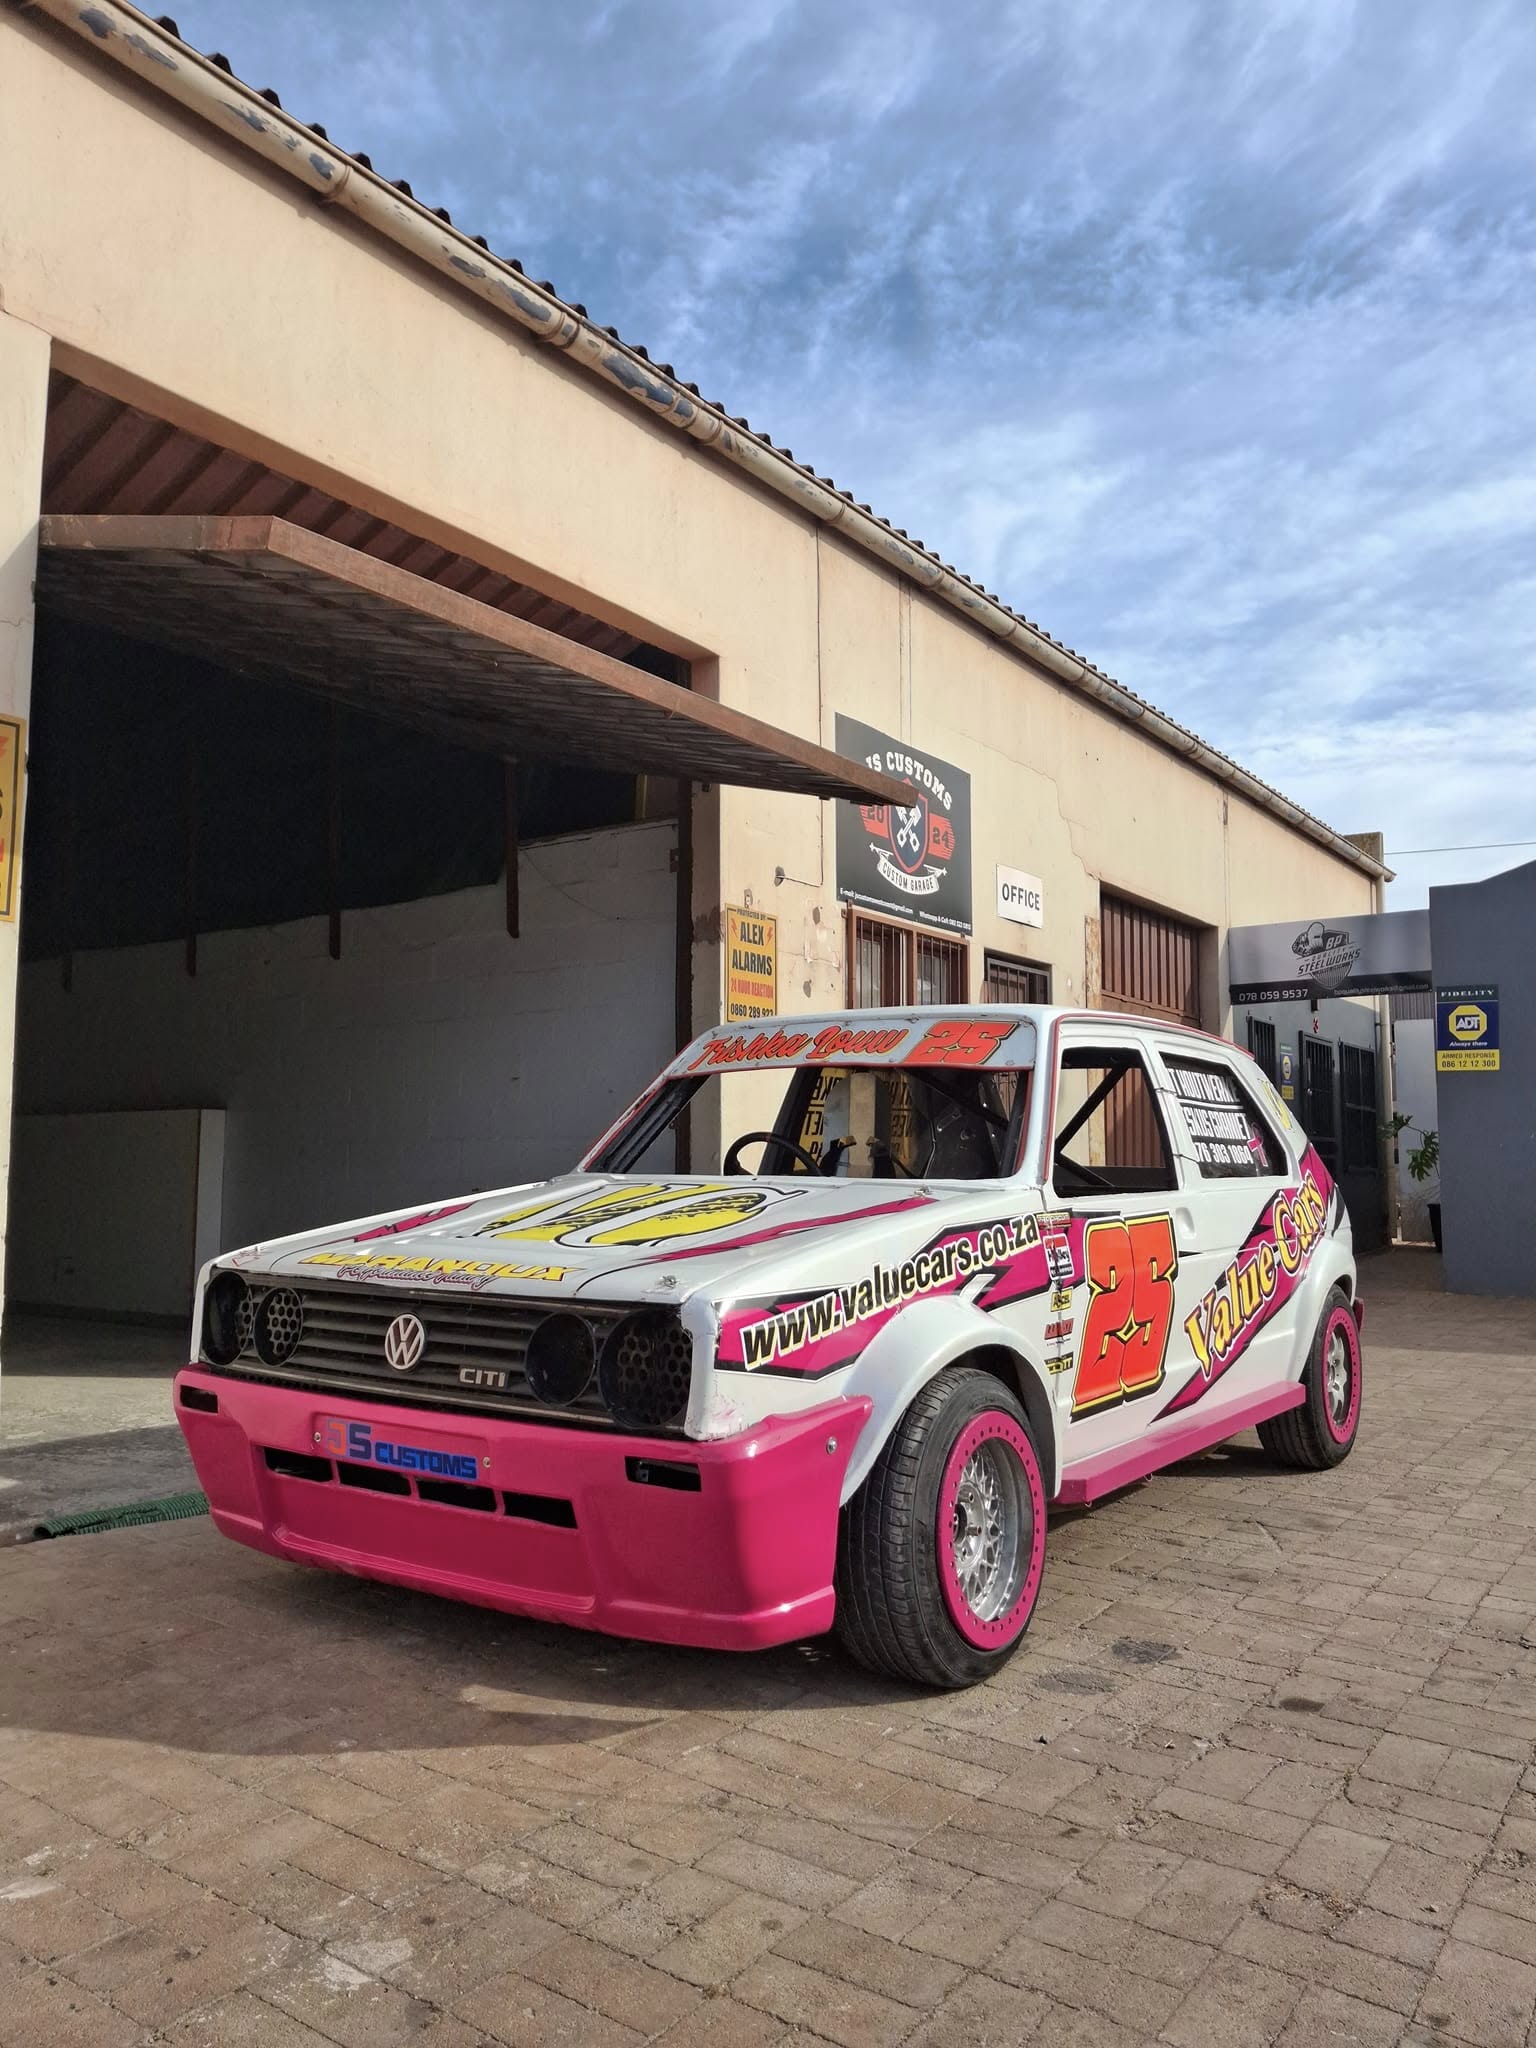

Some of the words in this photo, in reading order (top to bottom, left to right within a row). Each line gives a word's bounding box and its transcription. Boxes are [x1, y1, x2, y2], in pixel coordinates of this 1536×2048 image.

[886, 751, 952, 811] CUSTOMS
[932, 826, 952, 850] 24
[882, 862, 908, 890] CUSTOM
[910, 876, 935, 891] GARAGE
[1002, 883, 1040, 911] OFFICE
[740, 921, 764, 946] ALEX
[1326, 934, 1343, 950] BP
[732, 949, 773, 976] ALARMS
[1298, 948, 1360, 975] STEELWORKS
[731, 977, 737, 993] 24
[738, 979, 750, 995] HOUR
[751, 981, 773, 1000] REACTION
[1239, 991, 1257, 1001] 078
[1260, 991, 1279, 1000] 059
[1283, 989, 1309, 999] 9537
[730, 1003, 747, 1017] 0860
[749, 1006, 760, 1018] 289
[1456, 1016, 1480, 1030] ADT
[687, 1026, 811, 1071] Trishka
[904, 1020, 1019, 1063] 25
[1471, 1060, 1479, 1068] 12
[1209, 1143, 1230, 1164] 303
[1228, 1145, 1254, 1164] 1864
[298, 1253, 587, 1282] MARANOUX
[1184, 1243, 1278, 1379] Value
[1272, 1172, 1328, 1275] Cars
[741, 1213, 1040, 1367] www.valuecars.co.za
[1072, 1213, 1178, 1414] 25
[459, 1367, 506, 1387] CITI
[327, 1420, 373, 1460] JS
[374, 1441, 478, 1480] CUSTOMS
